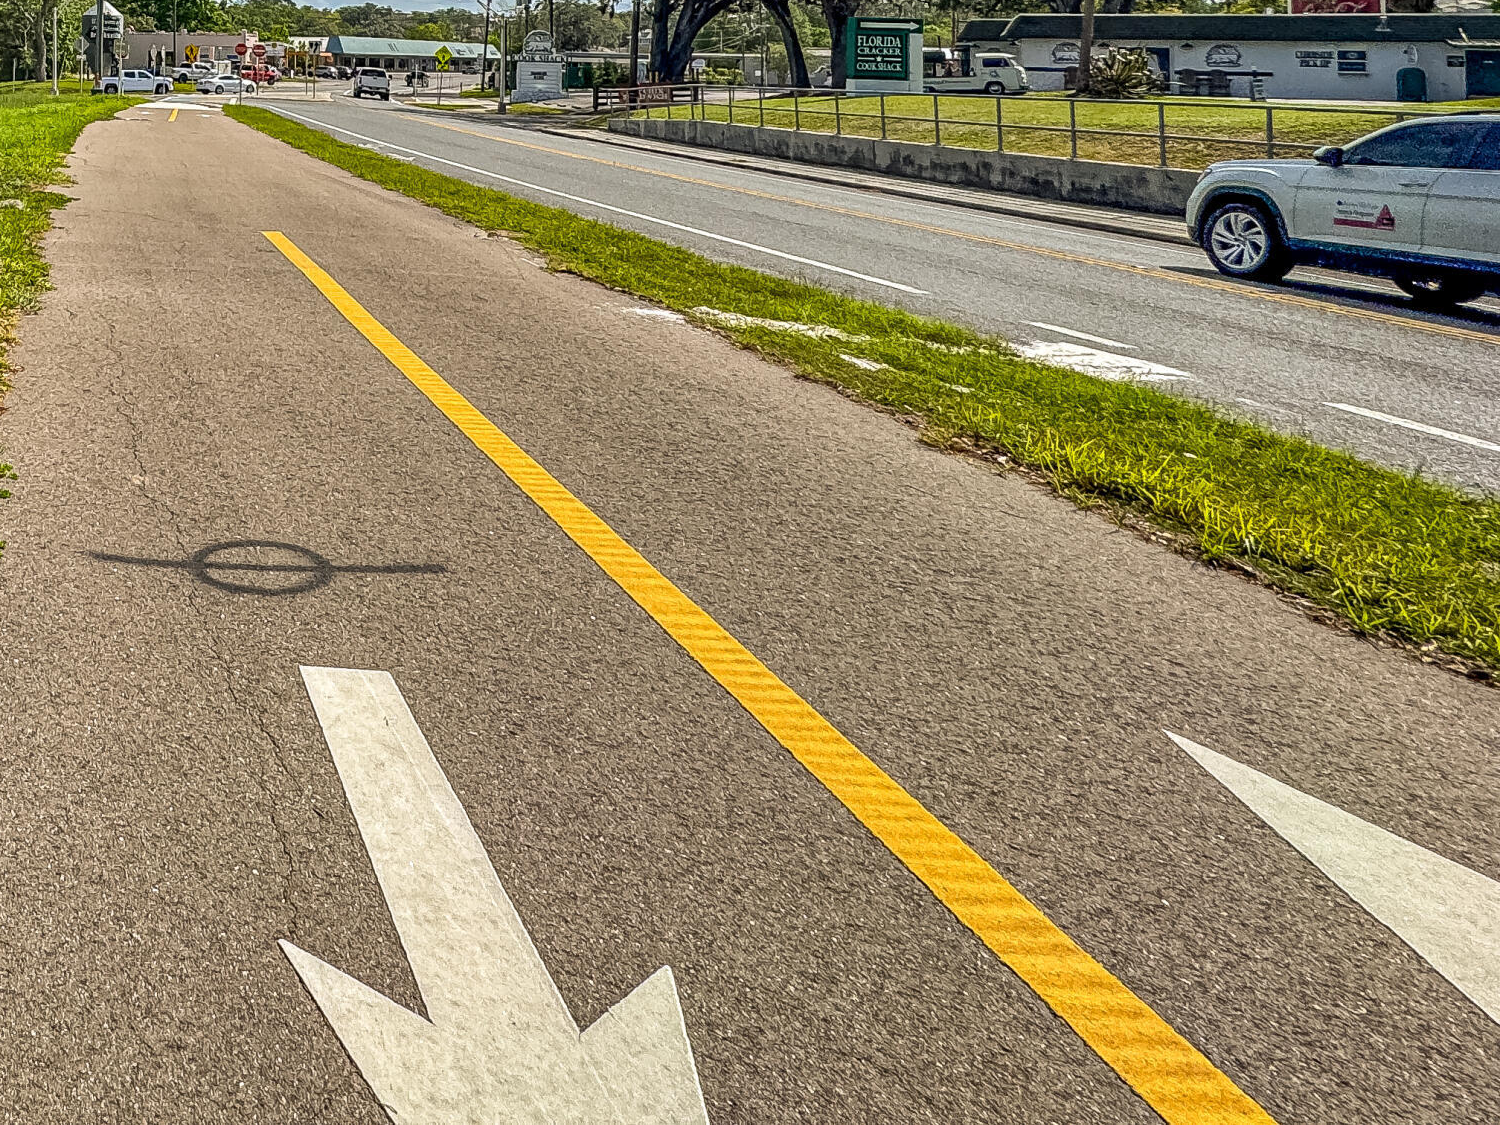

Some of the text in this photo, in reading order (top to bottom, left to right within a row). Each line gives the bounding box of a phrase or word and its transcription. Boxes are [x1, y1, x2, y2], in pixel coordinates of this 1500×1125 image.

[857, 35, 901, 47] FLORIDA
[857, 47, 902, 56] CRACKER
[857, 62, 902, 71] COOK SHACK
